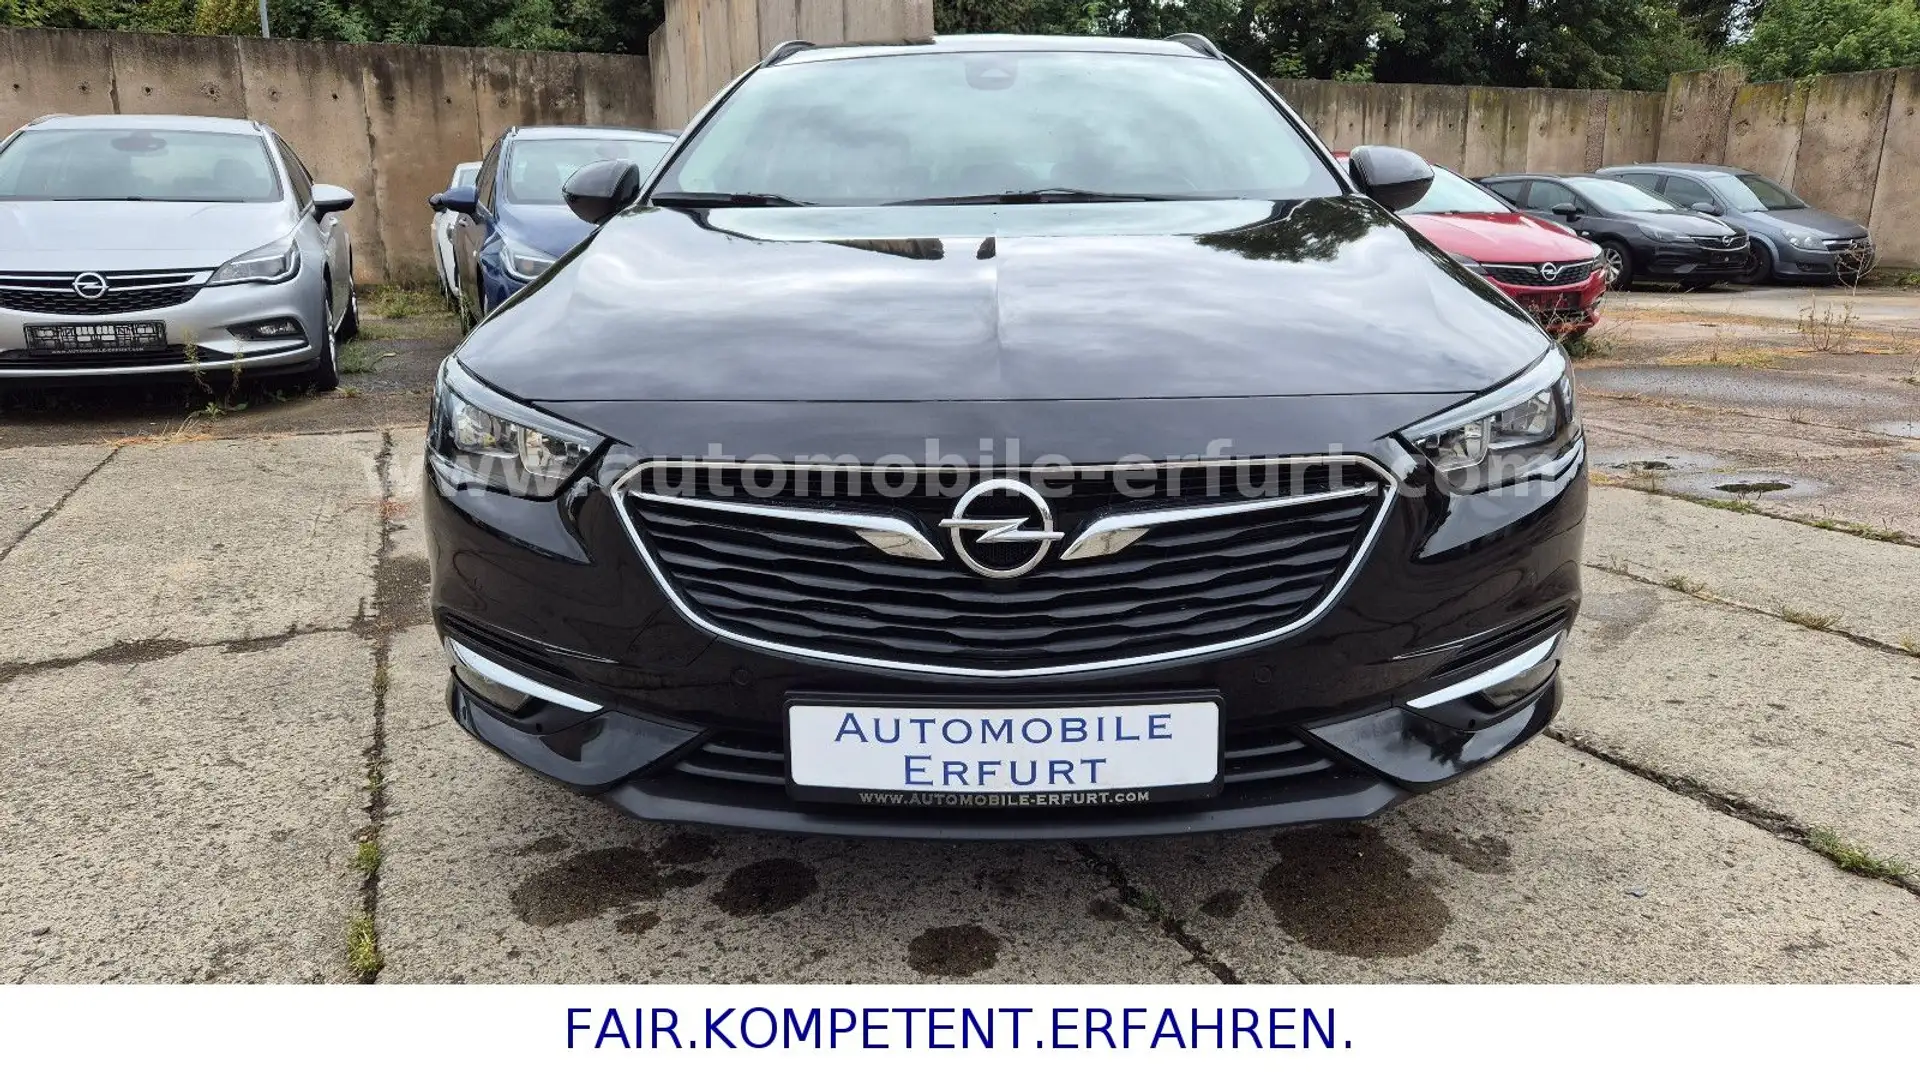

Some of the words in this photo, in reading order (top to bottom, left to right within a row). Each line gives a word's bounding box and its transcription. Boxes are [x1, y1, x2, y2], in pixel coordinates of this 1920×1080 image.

[834, 712, 1173, 744] AUTOMOBILE
[903, 754, 1107, 786] ERFURT
[859, 791, 1150, 806] WWW.AUTOMOBILE-ERFURT.COM
